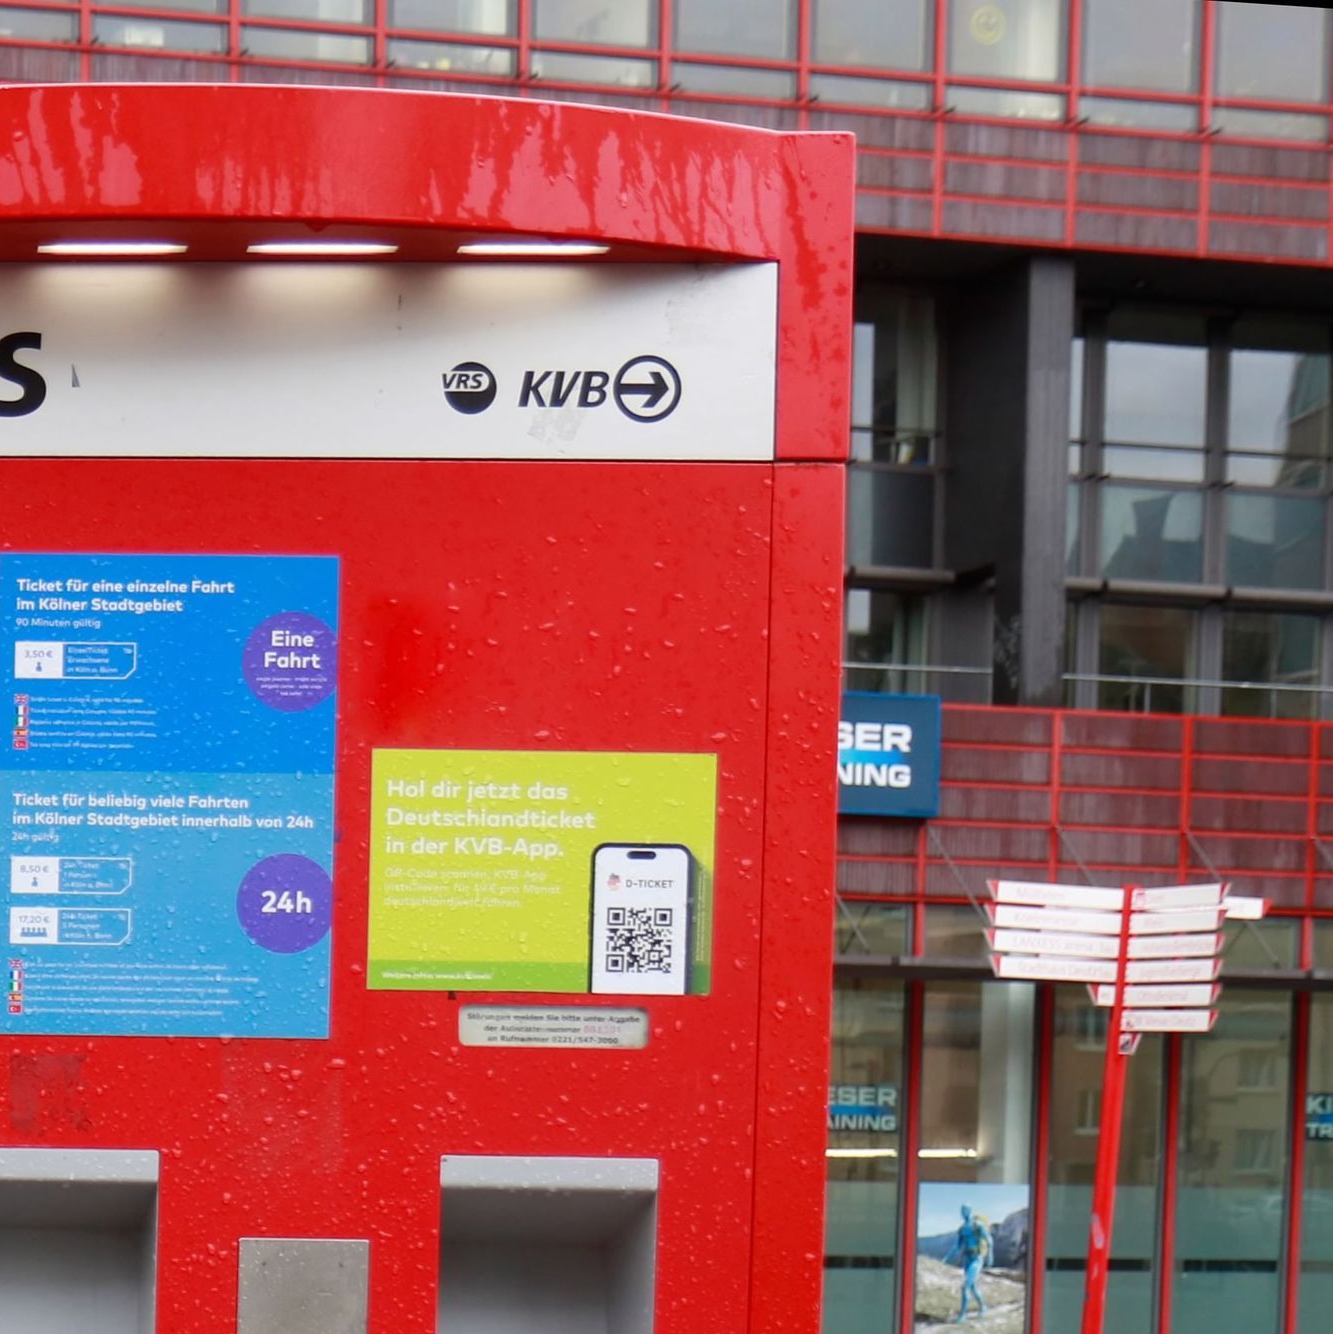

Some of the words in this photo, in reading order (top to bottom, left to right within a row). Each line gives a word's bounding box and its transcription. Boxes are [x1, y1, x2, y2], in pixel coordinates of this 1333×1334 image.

[441, 373, 483, 390] VRS
[518, 371, 609, 408] KVB
[16, 578, 63, 593] Ticket
[66, 578, 88, 592] für
[92, 579, 123, 593] eine
[127, 580, 187, 593] einzelne
[191, 580, 235, 594] Fahrt
[16, 597, 34, 611] im
[38, 597, 87, 611] Kölner
[91, 598, 183, 615] Stadtgebiet
[15, 618, 29, 627] 90
[30, 618, 71, 627] Minuten
[72, 618, 101, 629] gültig
[271, 630, 314, 647] Eine
[264, 651, 321, 669] Fahrt
[838, 720, 912, 752] SER
[837, 762, 911, 788] NING
[387, 779, 425, 798] Hol
[432, 780, 461, 799] dir
[467, 780, 520, 804] jetzt
[527, 781, 569, 800] das
[12, 793, 58, 806] Ticket
[63, 793, 84, 807] für
[88, 793, 146, 810] beliebig
[150, 795, 184, 808] viele
[188, 795, 249, 809] Fahrten
[12, 811, 31, 825] im
[34, 811, 83, 826] Kölner
[87, 812, 178, 830] Stadtgebiet
[182, 814, 253, 828] innerhalb
[255, 816, 282, 829] von
[285, 815, 314, 829] 24h
[386, 807, 596, 829] Deutschlandticket
[11, 832, 29, 842] 24h
[386, 835, 405, 854] in
[411, 836, 448, 855] der
[453, 836, 565, 860] KVB-App.
[625, 879, 674, 889] D-TICKET
[260, 890, 313, 913] 24h
[561, 1014, 581, 1023] bitte
